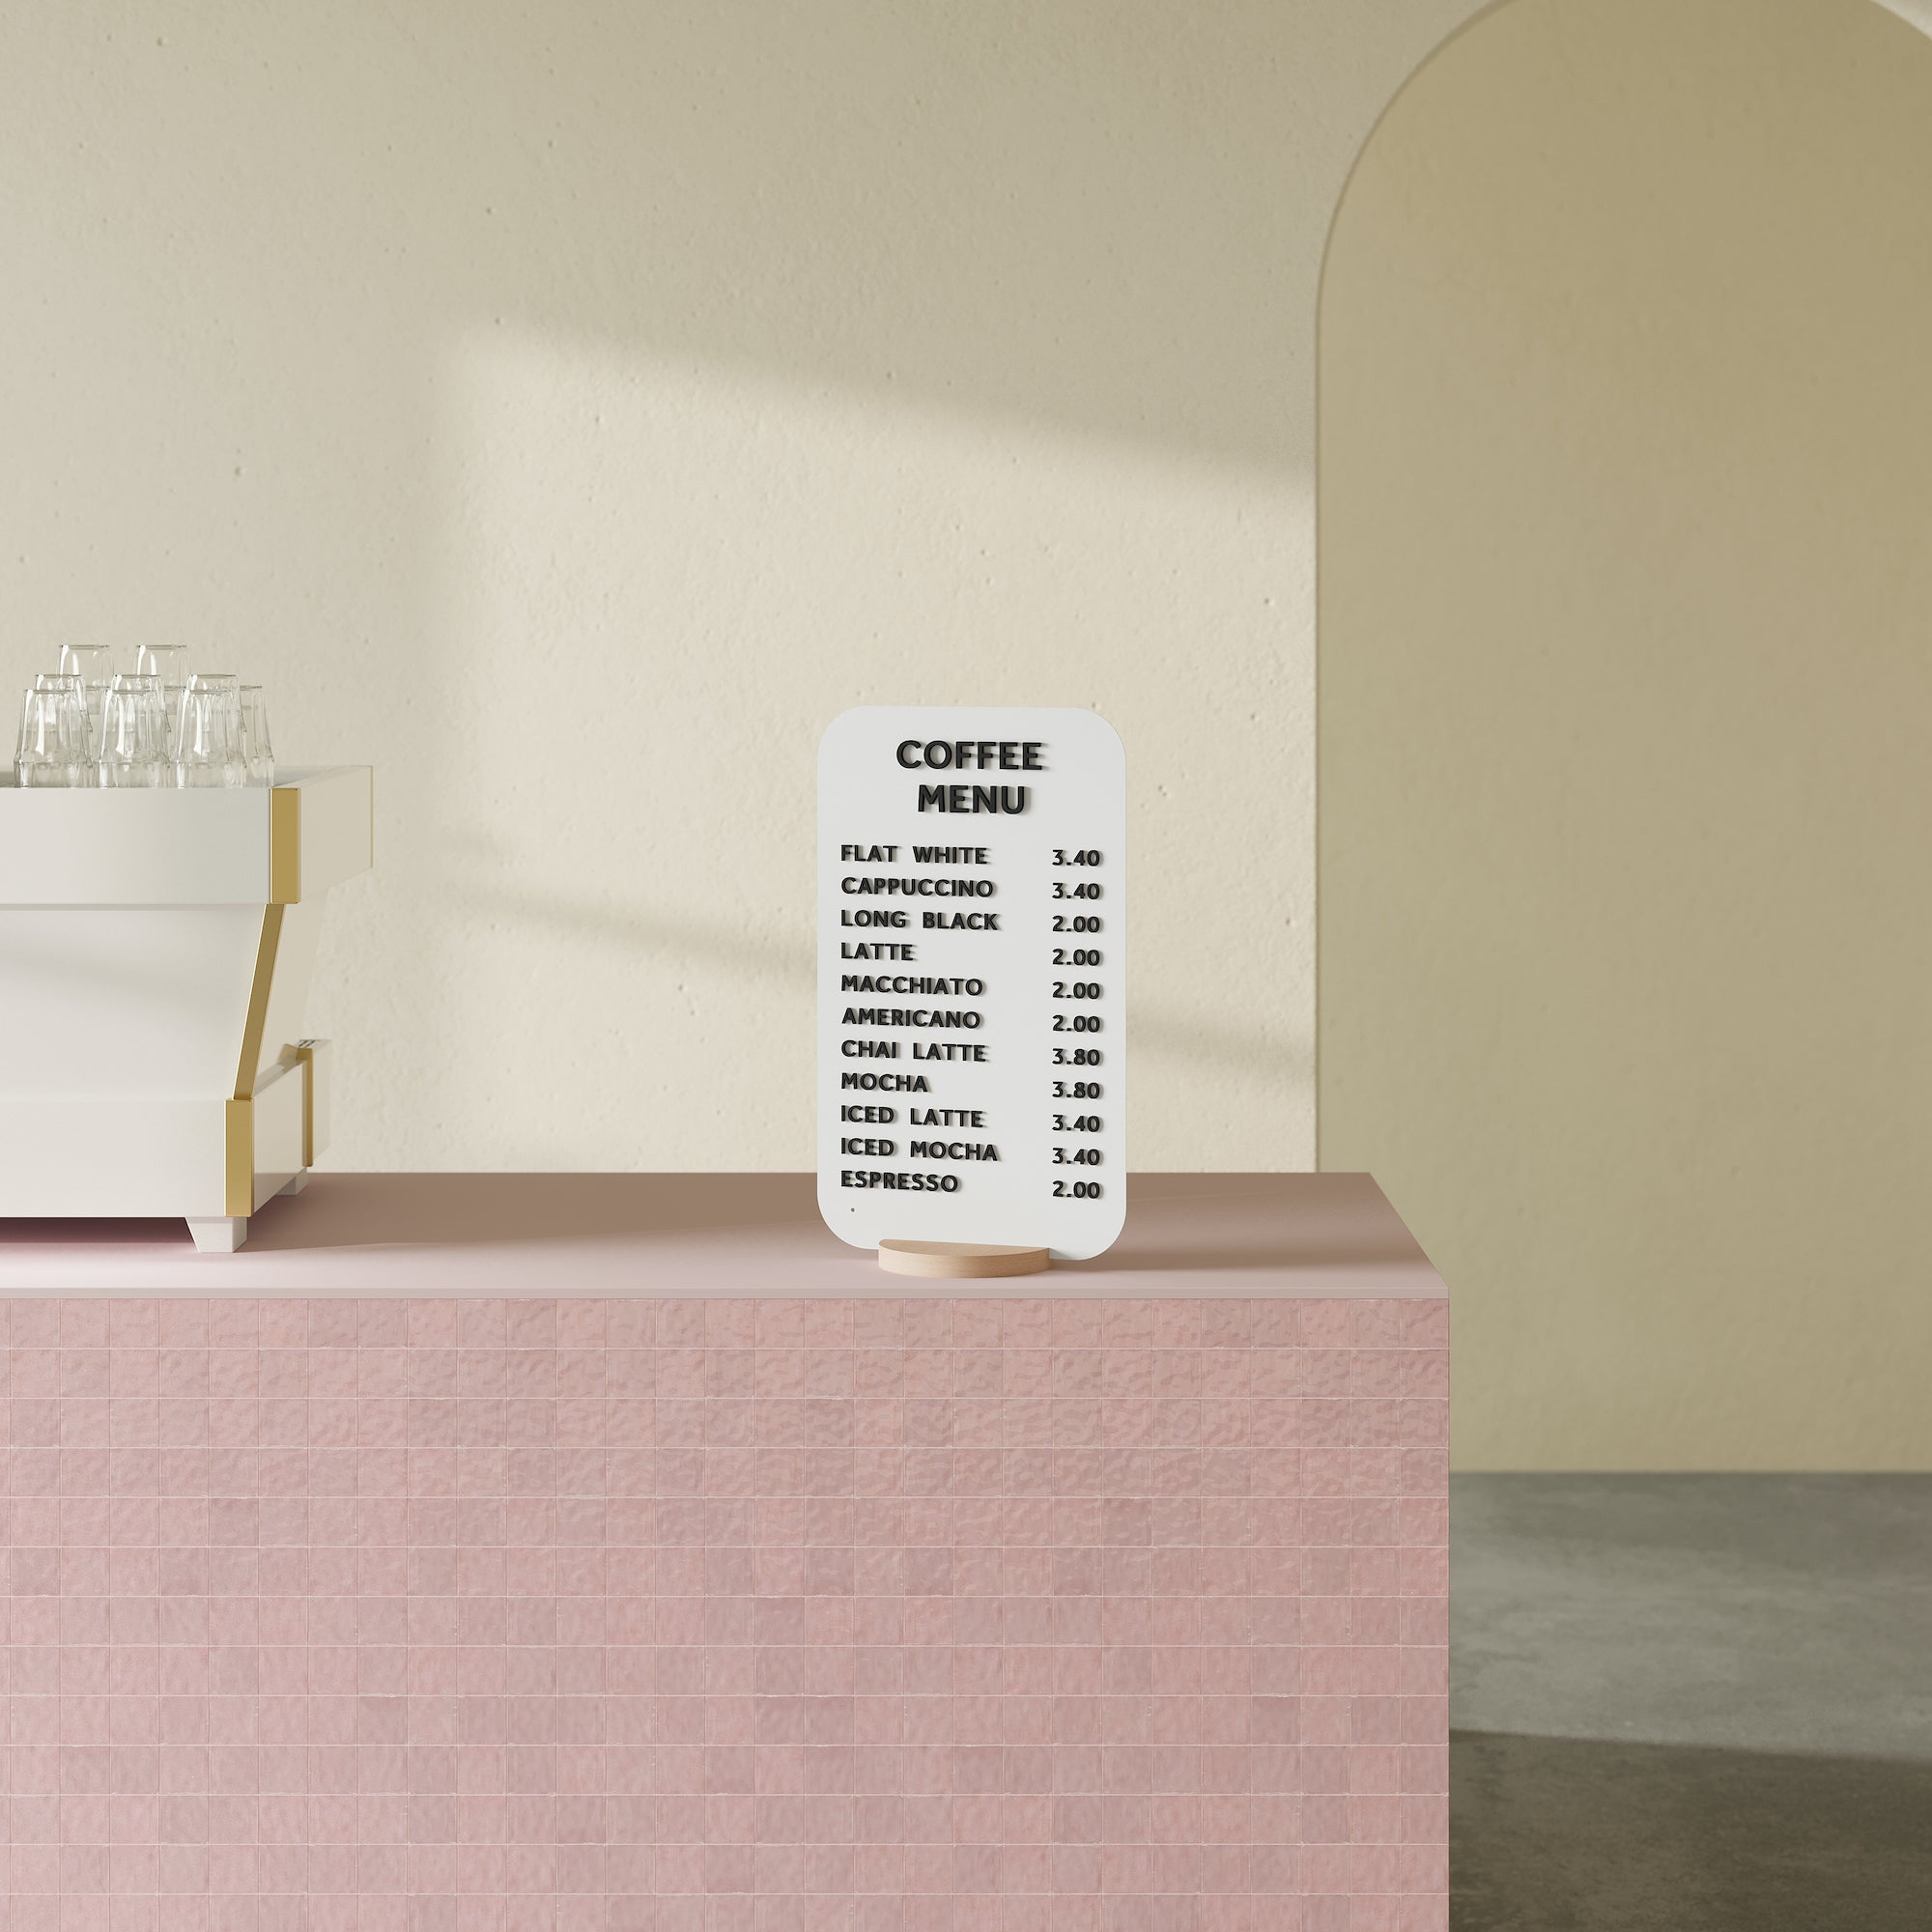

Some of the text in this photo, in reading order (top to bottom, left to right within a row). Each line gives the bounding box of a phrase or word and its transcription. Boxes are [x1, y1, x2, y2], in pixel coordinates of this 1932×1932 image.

[896, 740, 1043, 771] COFFEE
[918, 784, 1026, 815] MENU
[840, 844, 1100, 867] FLAT WHITE 3.40
[840, 877, 1100, 900] CAPPUCCINO 3.40
[840, 909, 1100, 933] LONG BLACK 2.00
[840, 942, 1100, 967] LATTE 2.00
[840, 975, 1100, 1000] MACCHIATO 2.00
[841, 1007, 1100, 1034] AMERICANO 2.00
[840, 1039, 1101, 1066] CHAI LATTE 3.80
[840, 1072, 1100, 1099] MOCHA 3.80
[840, 1104, 1100, 1133] ICED LATTE 3.40
[840, 1137, 1100, 1166] ICED MOCHA 3.40
[840, 1170, 1101, 1200] ESPRESSO 2.00
